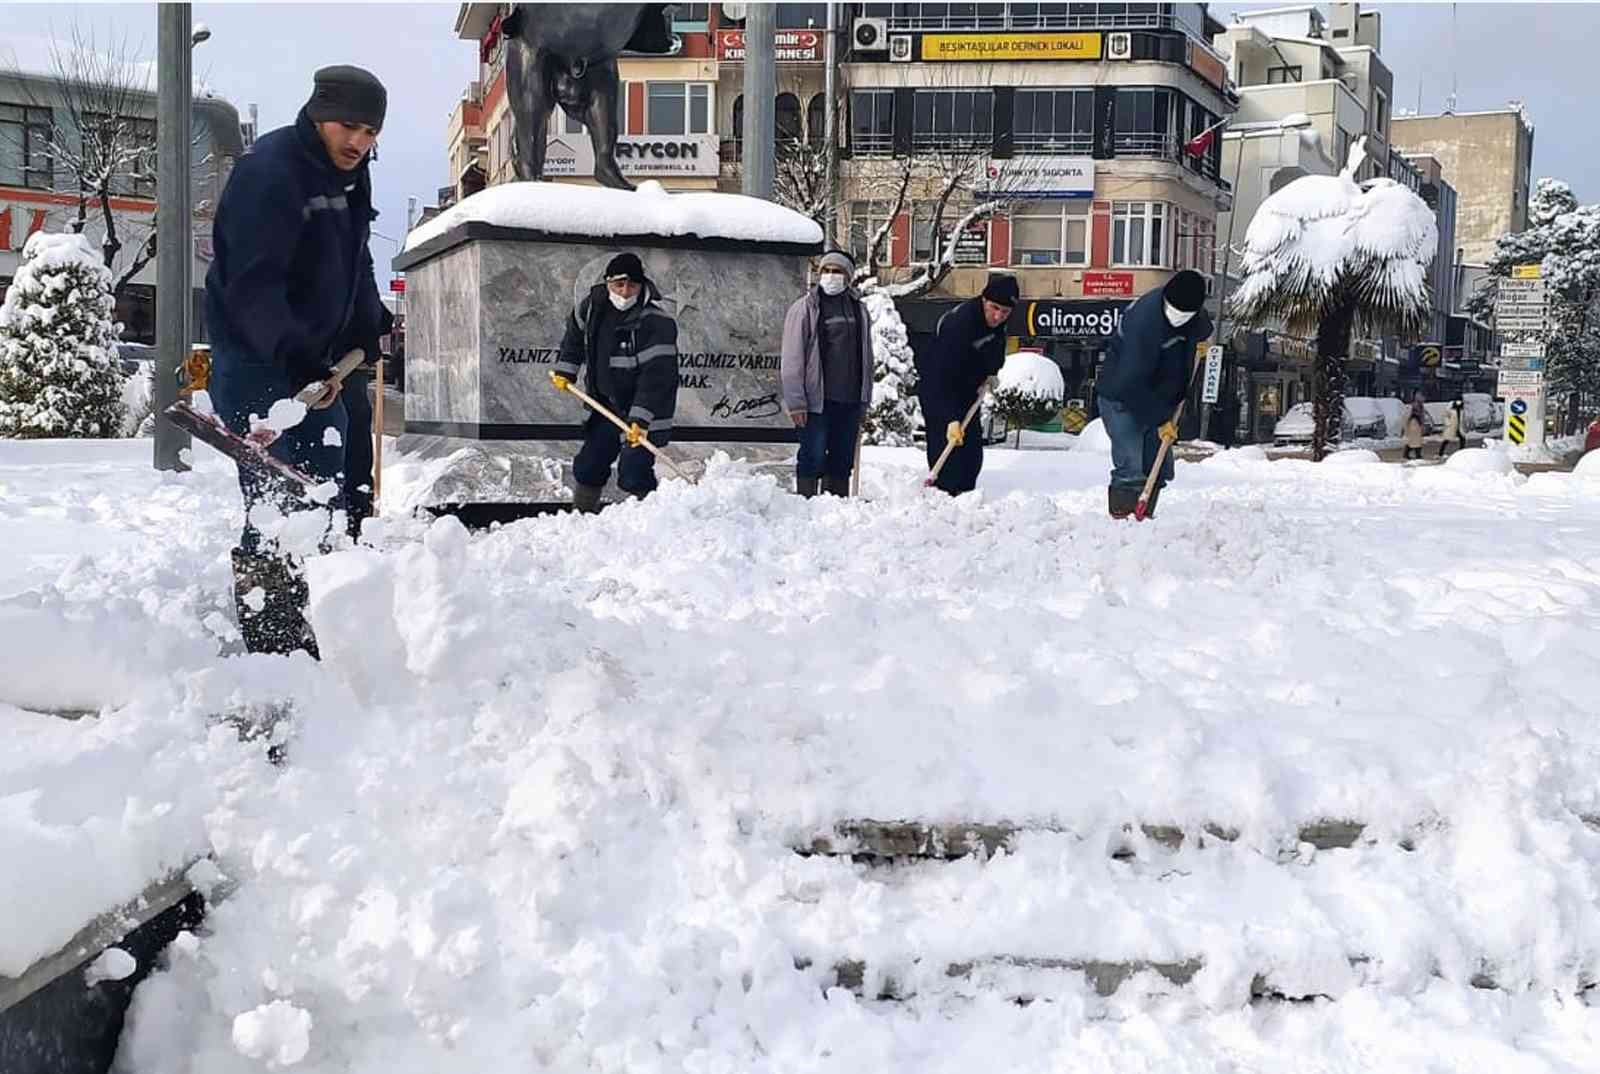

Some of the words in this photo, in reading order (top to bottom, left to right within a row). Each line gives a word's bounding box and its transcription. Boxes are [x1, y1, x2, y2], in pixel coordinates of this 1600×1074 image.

[939, 40, 1009, 55] BEŞİKTAŞLILAR
[1012, 40, 1048, 51] DERNEK
[1038, 308, 1118, 335] alimoğl
[1052, 327, 1097, 335] BAKLAVA
[499, 347, 552, 364] YALNIZ
[679, 353, 736, 369] YACIMIZ
[738, 353, 781, 370] VARDI
[679, 374, 712, 389] MAK.
